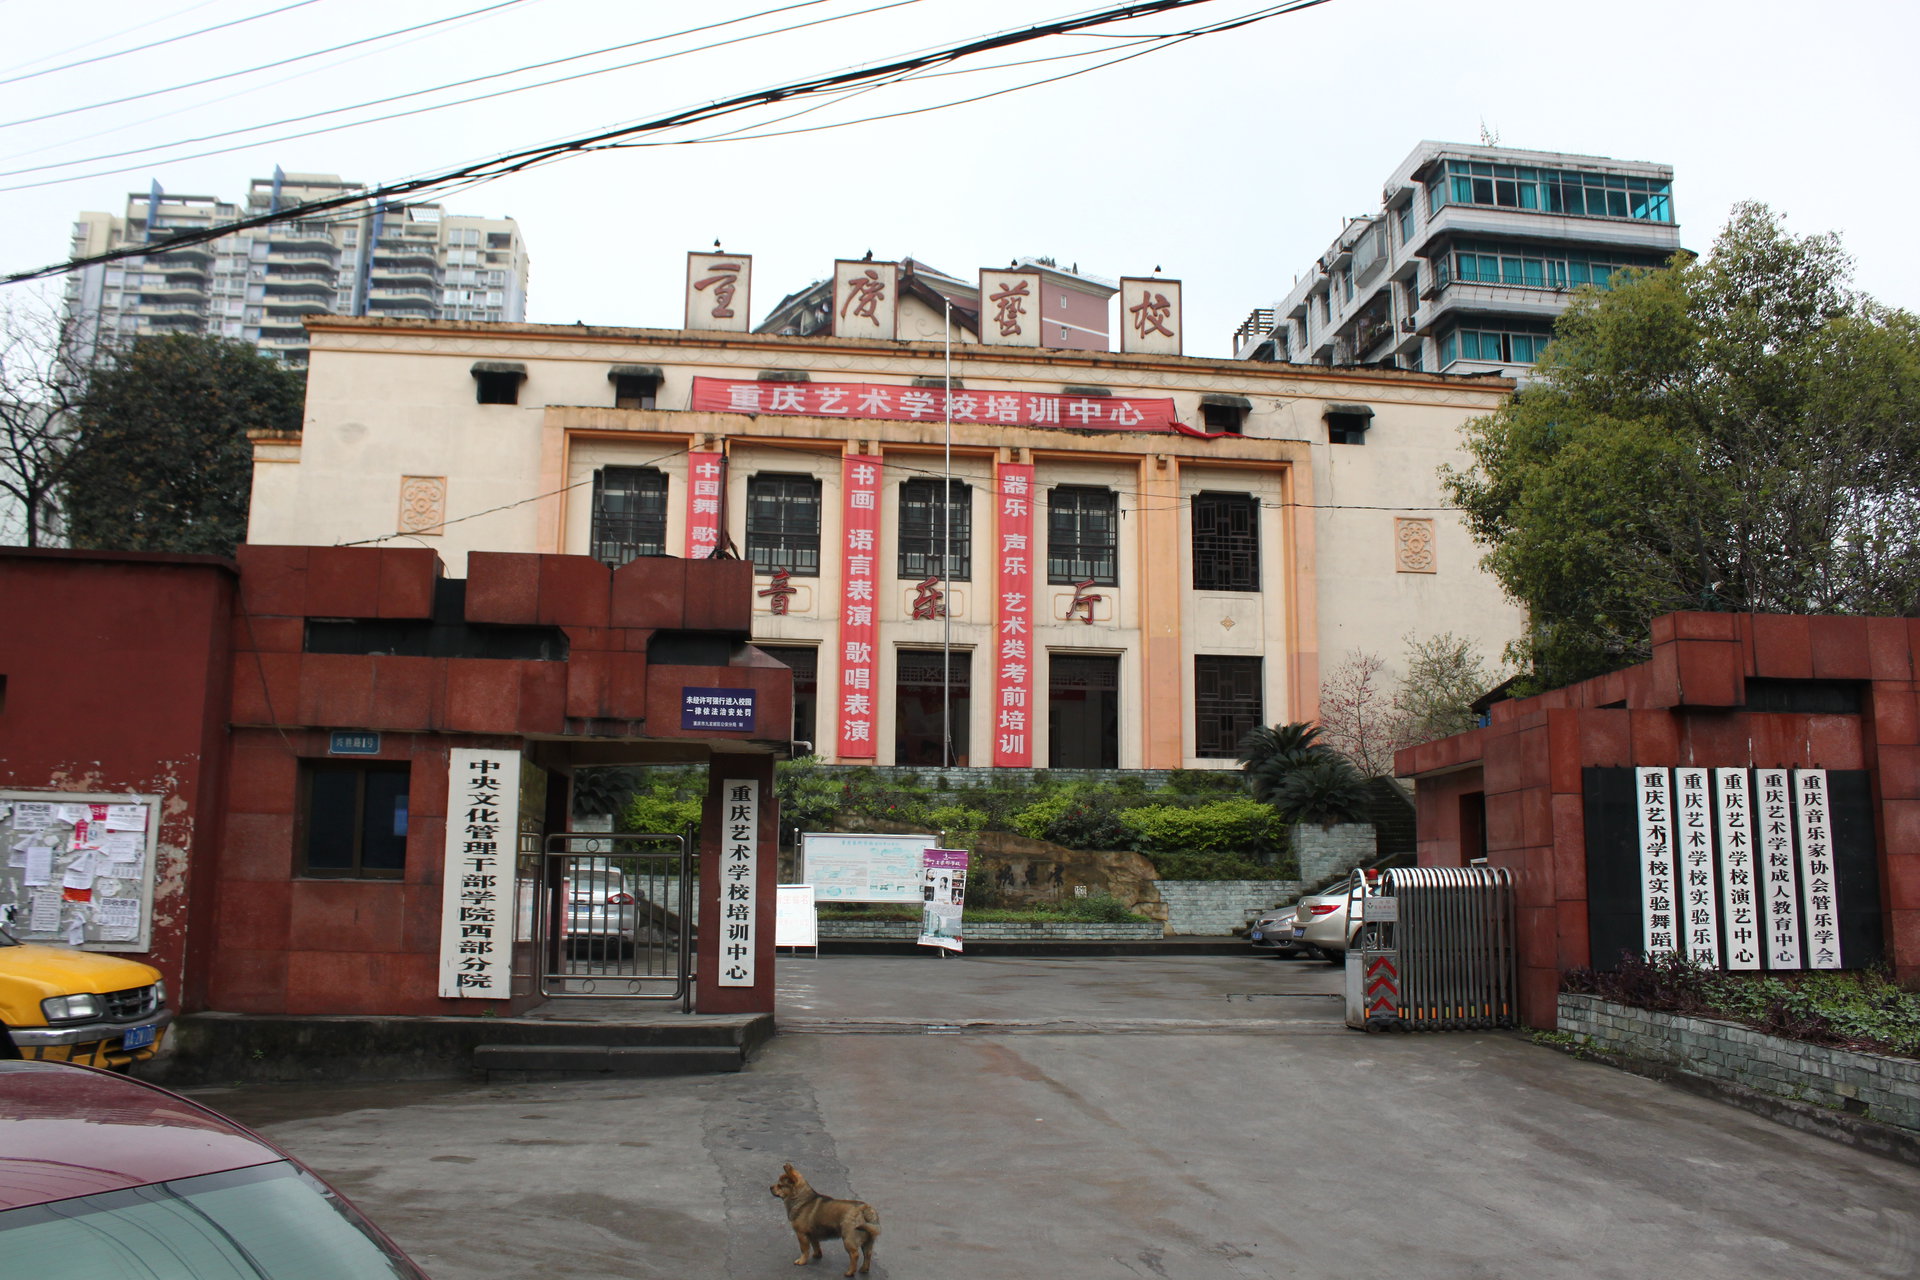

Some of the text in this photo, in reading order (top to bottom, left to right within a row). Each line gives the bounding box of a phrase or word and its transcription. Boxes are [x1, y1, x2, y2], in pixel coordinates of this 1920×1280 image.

[692, 462, 720, 514] 中国舞
[727, 383, 1144, 427] 重庆艺术学校培训中心
[844, 463, 876, 742] 书画 语言表演 歌唱表演
[999, 475, 1029, 756] 器乐 声乐 艺术类考前培训
[686, 696, 752, 706] 未经许可强行进入校园
[686, 707, 752, 717] 一律依法治安处罚
[455, 758, 502, 990] 中央文化管理干部学院西部分院
[725, 785, 752, 980] 重庆艺术学校培训中心
[1724, 773, 1754, 964] 重庆艺术学校演艺中心
[1764, 774, 1795, 963] 重庆艺术学校成人教育中心
[1802, 775, 1834, 964] 重庆音乐家协会管乐学会
